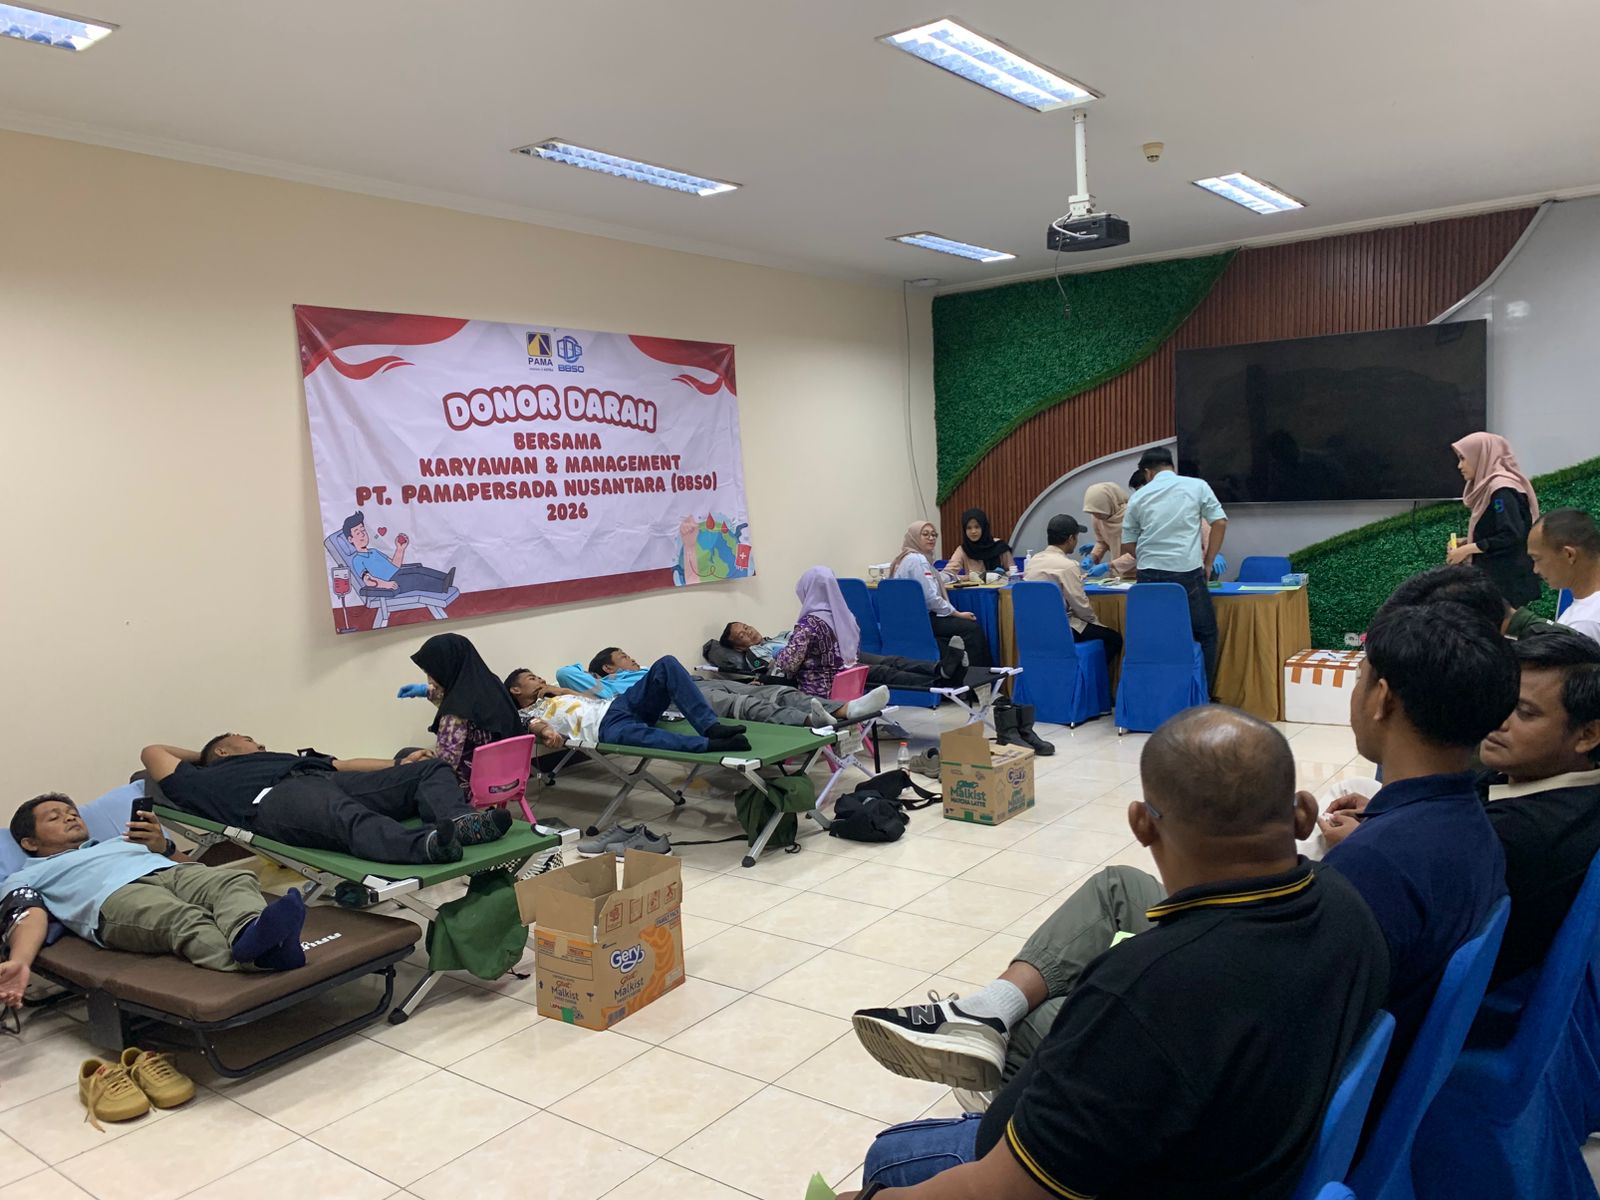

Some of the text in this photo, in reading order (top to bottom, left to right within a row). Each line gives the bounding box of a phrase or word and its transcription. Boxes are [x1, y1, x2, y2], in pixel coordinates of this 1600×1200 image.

[528, 357, 553, 366] PAMA
[558, 364, 584, 373] BBSO
[443, 384, 657, 433] DONOR DARAH
[513, 432, 602, 450] BERSAMA
[419, 455, 681, 477] KARYAWAN & MANAGEMENT
[356, 471, 718, 506] PT. PAMAPERSADA NUSANTARA (BBSO)
[546, 502, 589, 521] 2026
[610, 943, 646, 974] Gery
[551, 985, 579, 1001] Malkist
[614, 977, 644, 1000] Malkist
